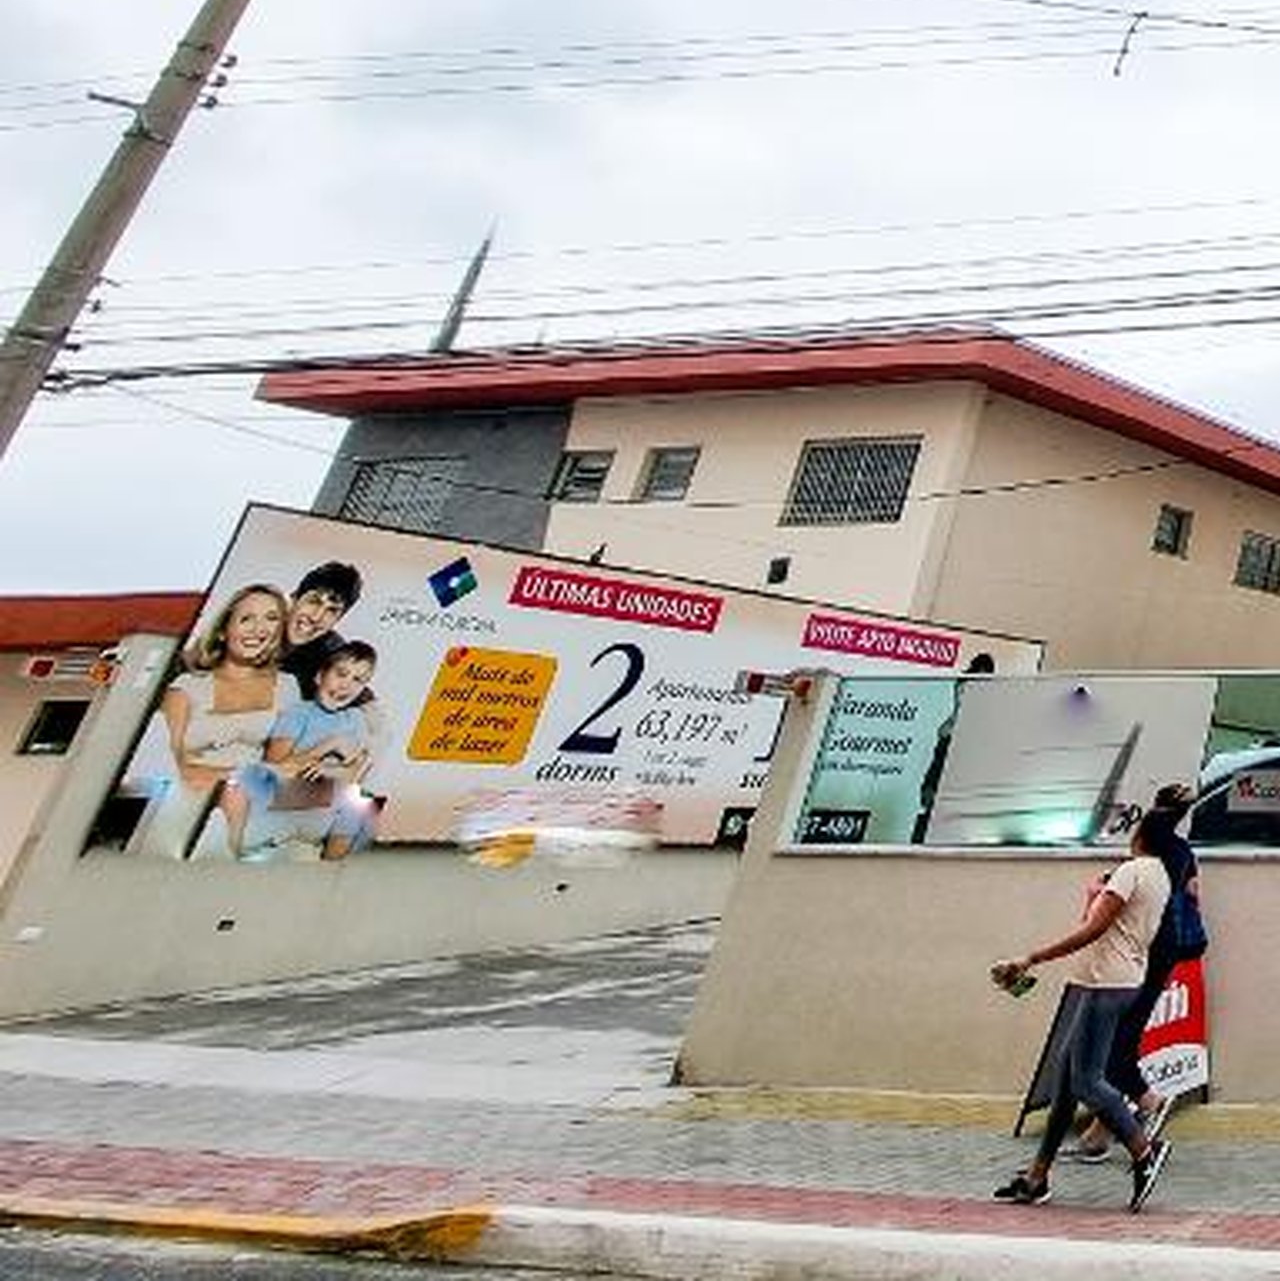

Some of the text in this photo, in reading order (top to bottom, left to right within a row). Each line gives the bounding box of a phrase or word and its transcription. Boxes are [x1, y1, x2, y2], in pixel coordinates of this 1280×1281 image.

[616, 590, 714, 624] UNIDADES
[558, 642, 645, 754] 2
[535, 757, 620, 783] dorms
